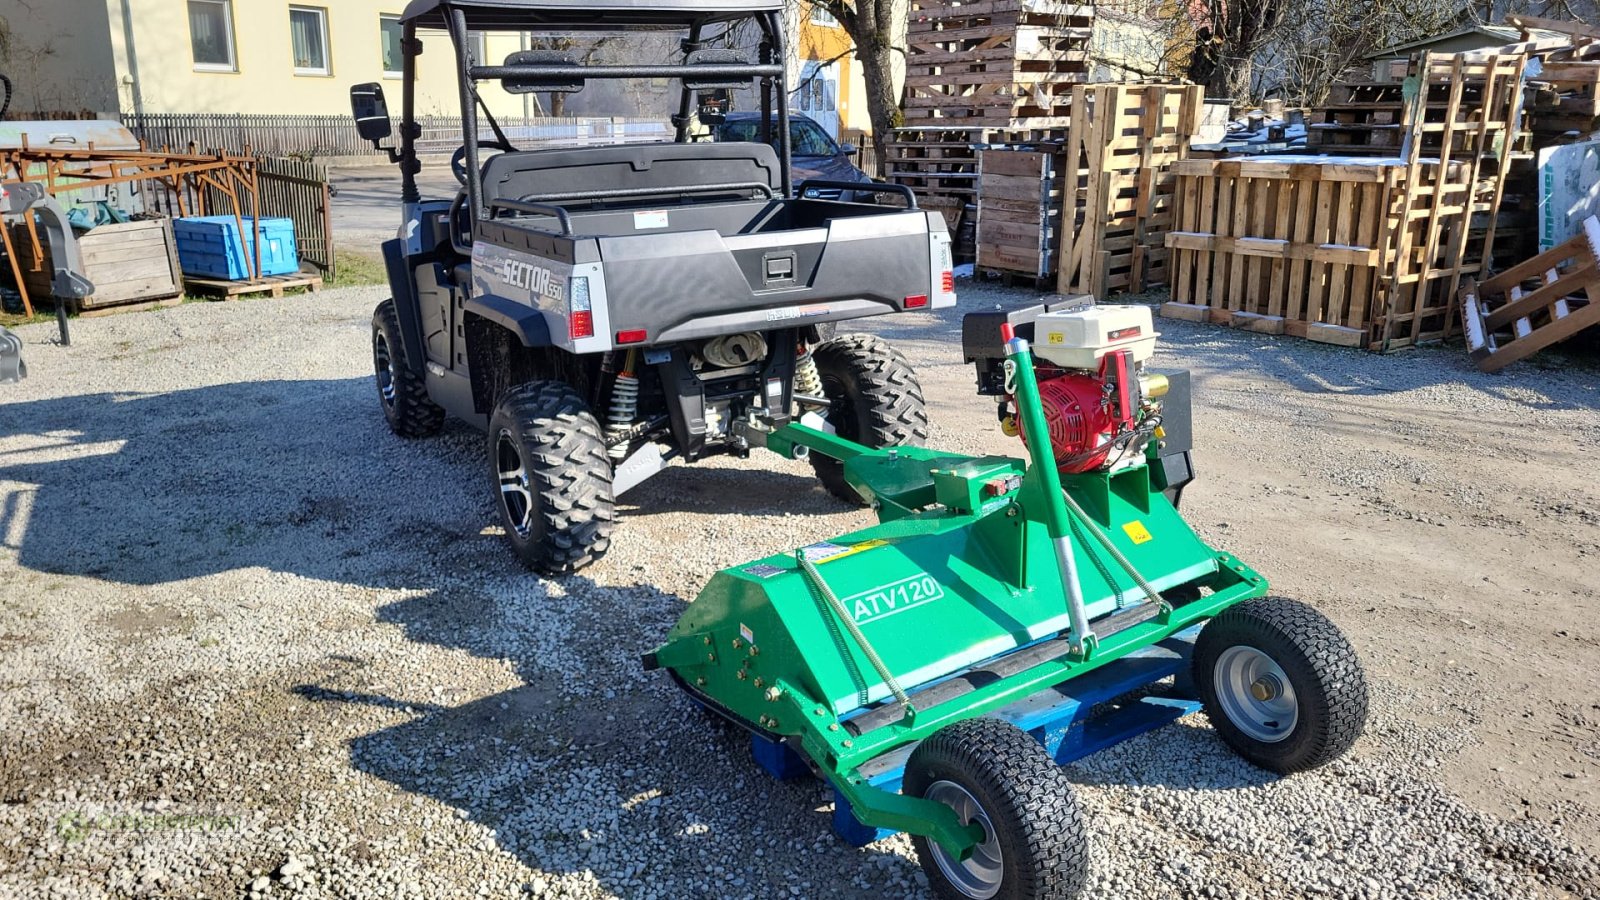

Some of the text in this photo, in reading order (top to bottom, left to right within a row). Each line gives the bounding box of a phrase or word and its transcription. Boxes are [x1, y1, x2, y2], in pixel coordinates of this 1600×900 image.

[503, 258, 563, 301] SECTOR 550
[854, 577, 936, 621] ATV120
